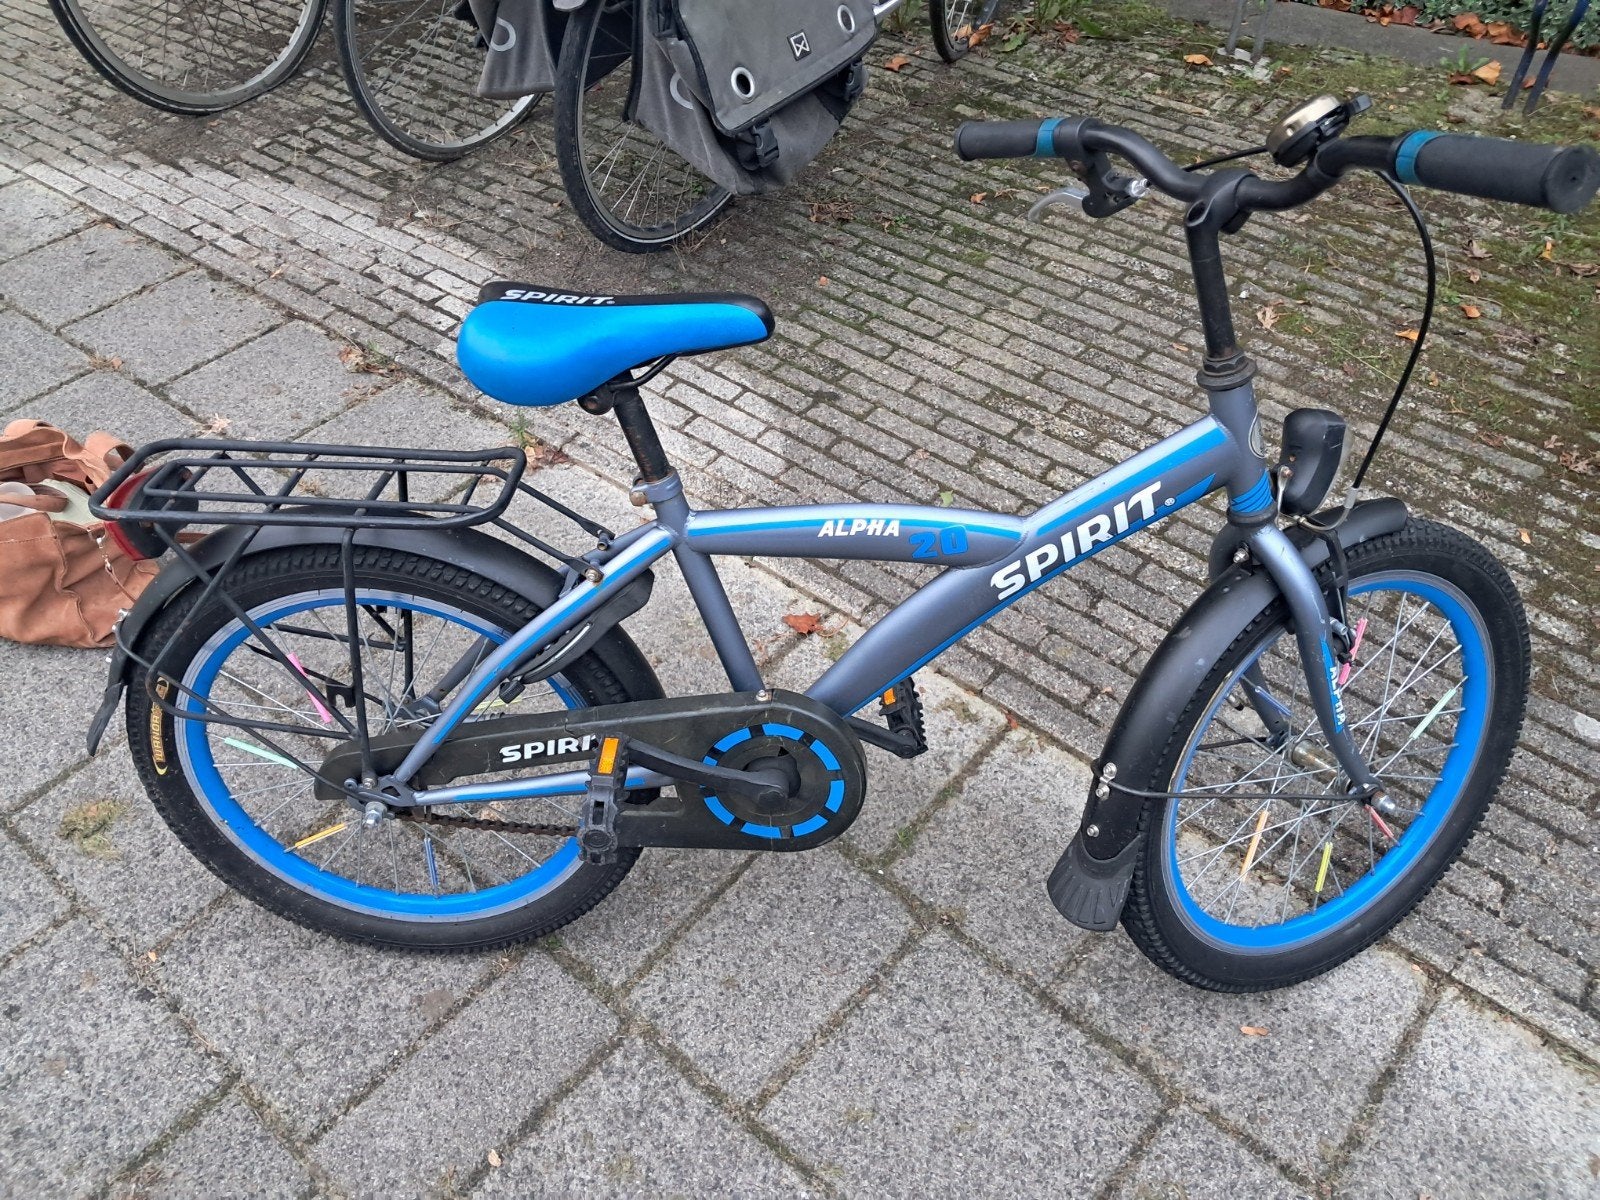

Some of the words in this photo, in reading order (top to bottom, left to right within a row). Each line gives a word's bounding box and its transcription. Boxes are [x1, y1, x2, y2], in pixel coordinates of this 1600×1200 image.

[500, 289, 614, 305] SPIRIT
[817, 518, 900, 538] ALPHA
[908, 525, 969, 560] 20
[990, 480, 1162, 600] SPIRIT
[499, 735, 597, 763] SPIRI
